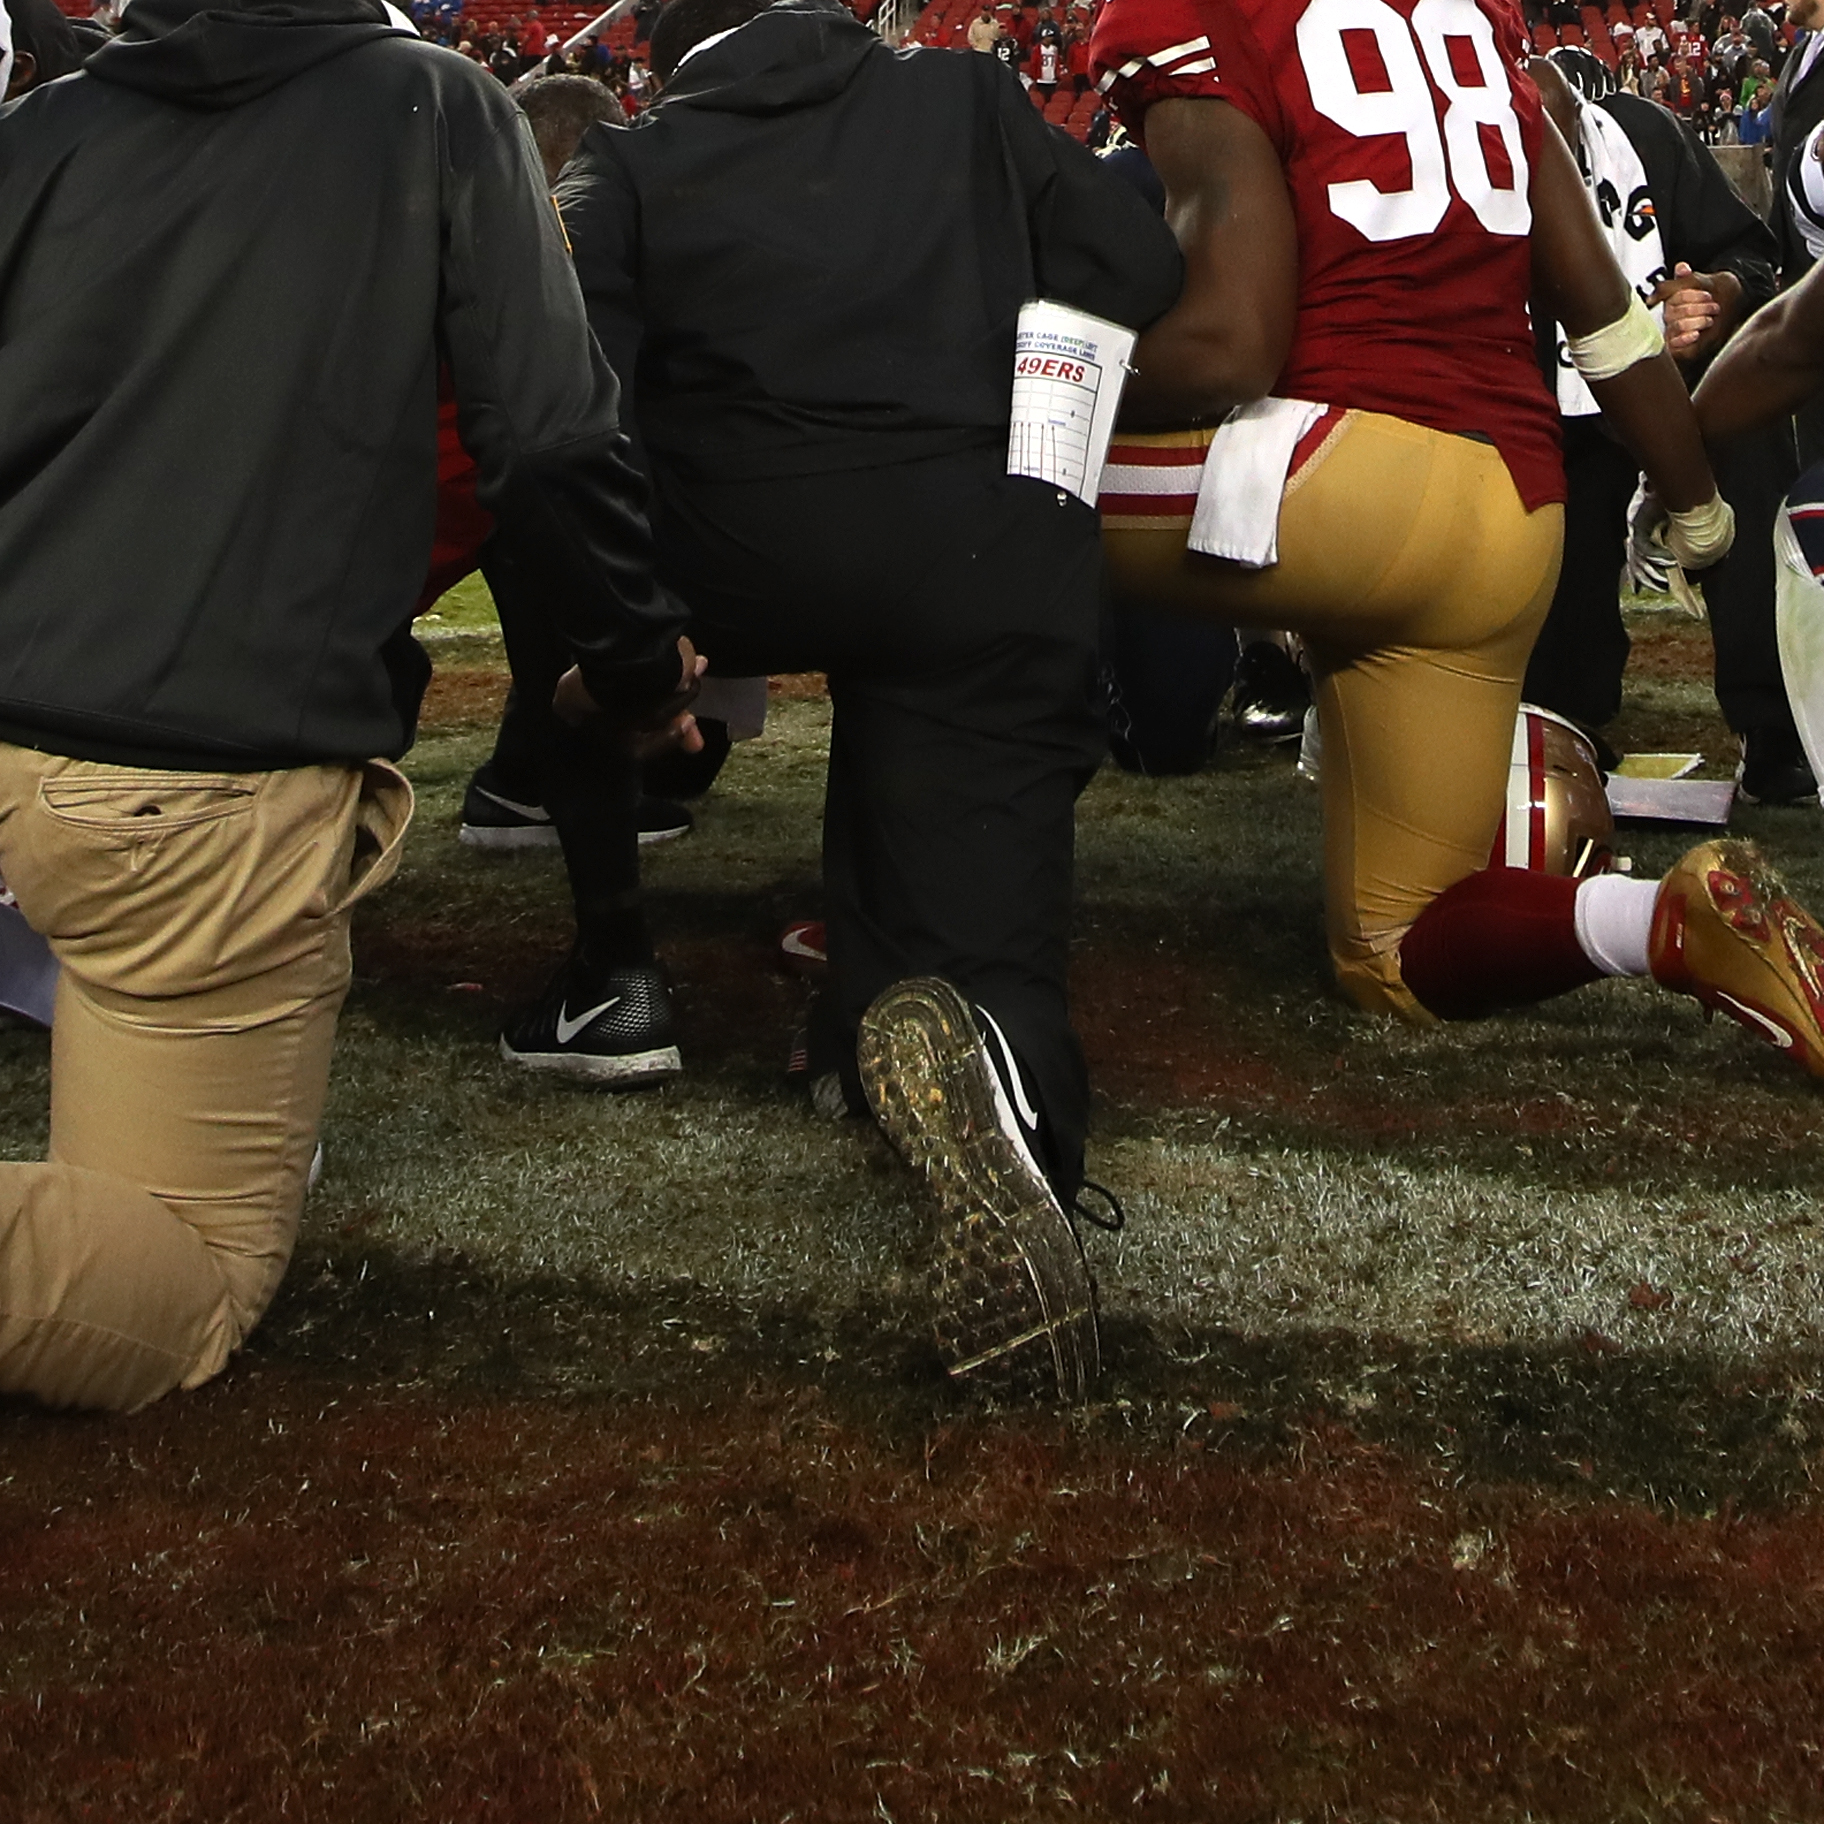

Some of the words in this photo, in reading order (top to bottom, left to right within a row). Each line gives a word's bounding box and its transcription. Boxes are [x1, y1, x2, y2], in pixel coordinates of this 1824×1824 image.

[997, 47, 1011, 62] 12
[1688, 41, 1702, 57] 12
[1034, 341, 1078, 356] COVERAGE
[1016, 356, 1086, 384] 49ERS
